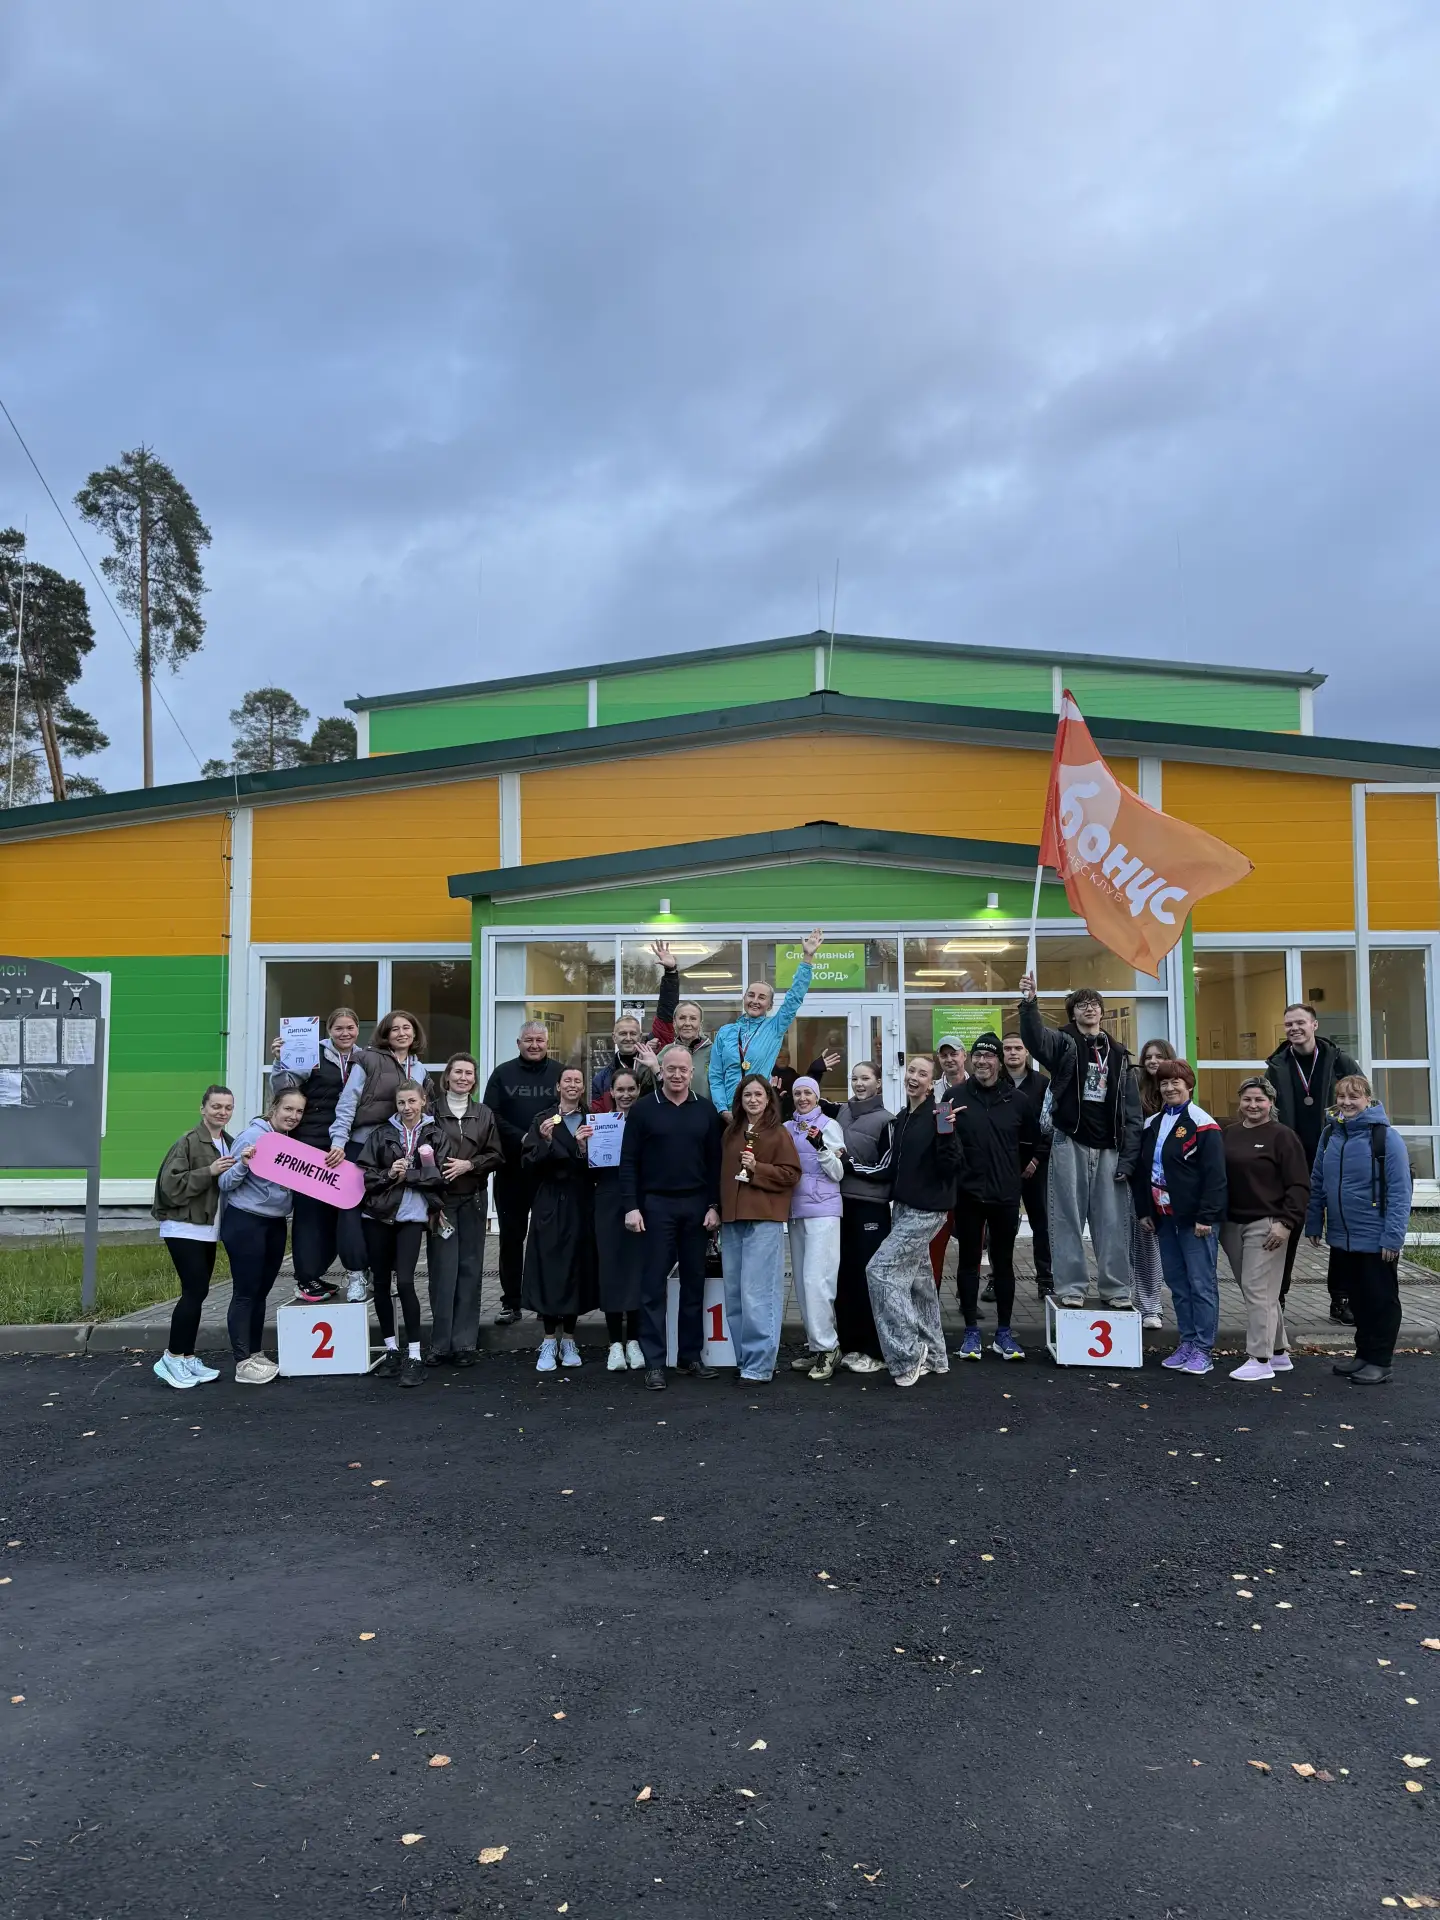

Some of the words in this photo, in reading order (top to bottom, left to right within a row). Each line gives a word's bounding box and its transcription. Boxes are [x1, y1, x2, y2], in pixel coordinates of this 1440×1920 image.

[785, 950, 854, 959] Спотивный
[311, 1321, 335, 1359] 2
[706, 1302, 729, 1342] 1
[1087, 1319, 1113, 1358] 3
